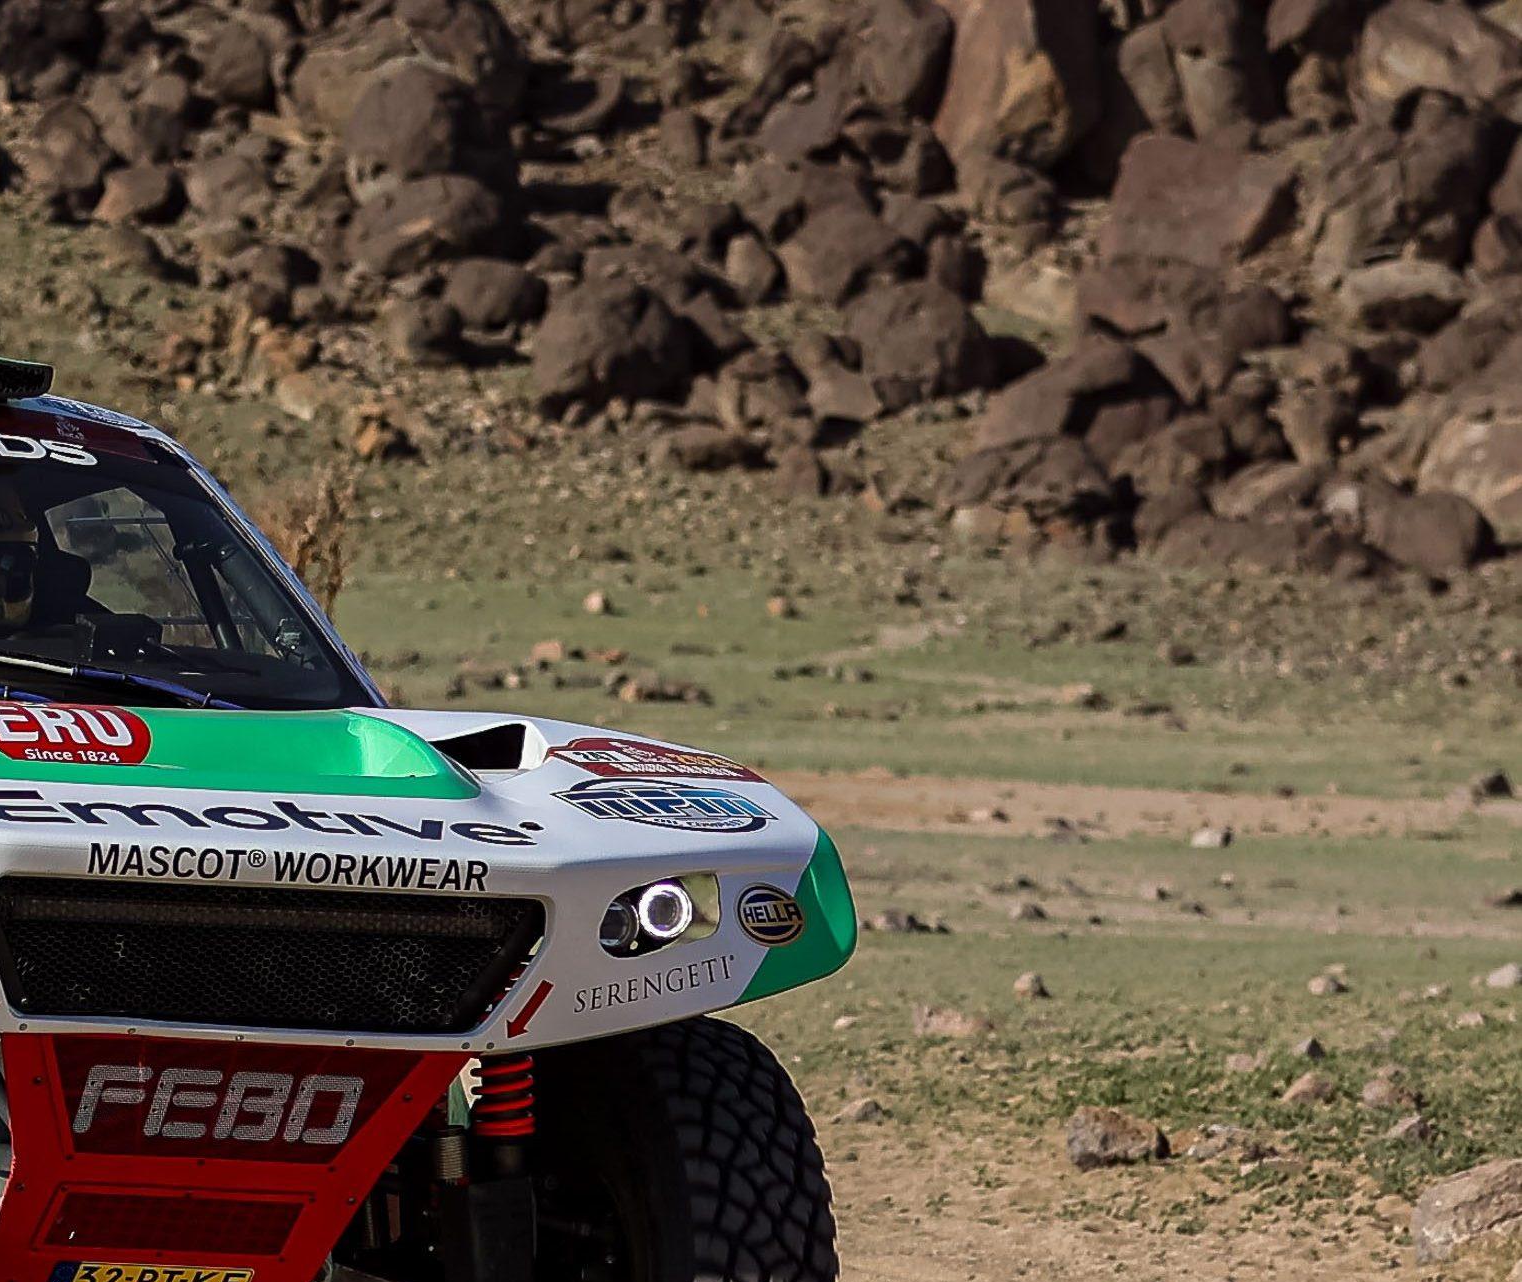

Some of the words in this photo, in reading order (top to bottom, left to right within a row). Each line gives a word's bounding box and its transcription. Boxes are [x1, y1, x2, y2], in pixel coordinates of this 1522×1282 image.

[24, 746, 74, 762] Since
[76, 750, 121, 764] 1824
[274, 851, 490, 892] WORKWEAR
[743, 901, 804, 924] HELLA
[573, 955, 732, 1014] SERENGETI
[73, 1064, 364, 1145] FEBO
